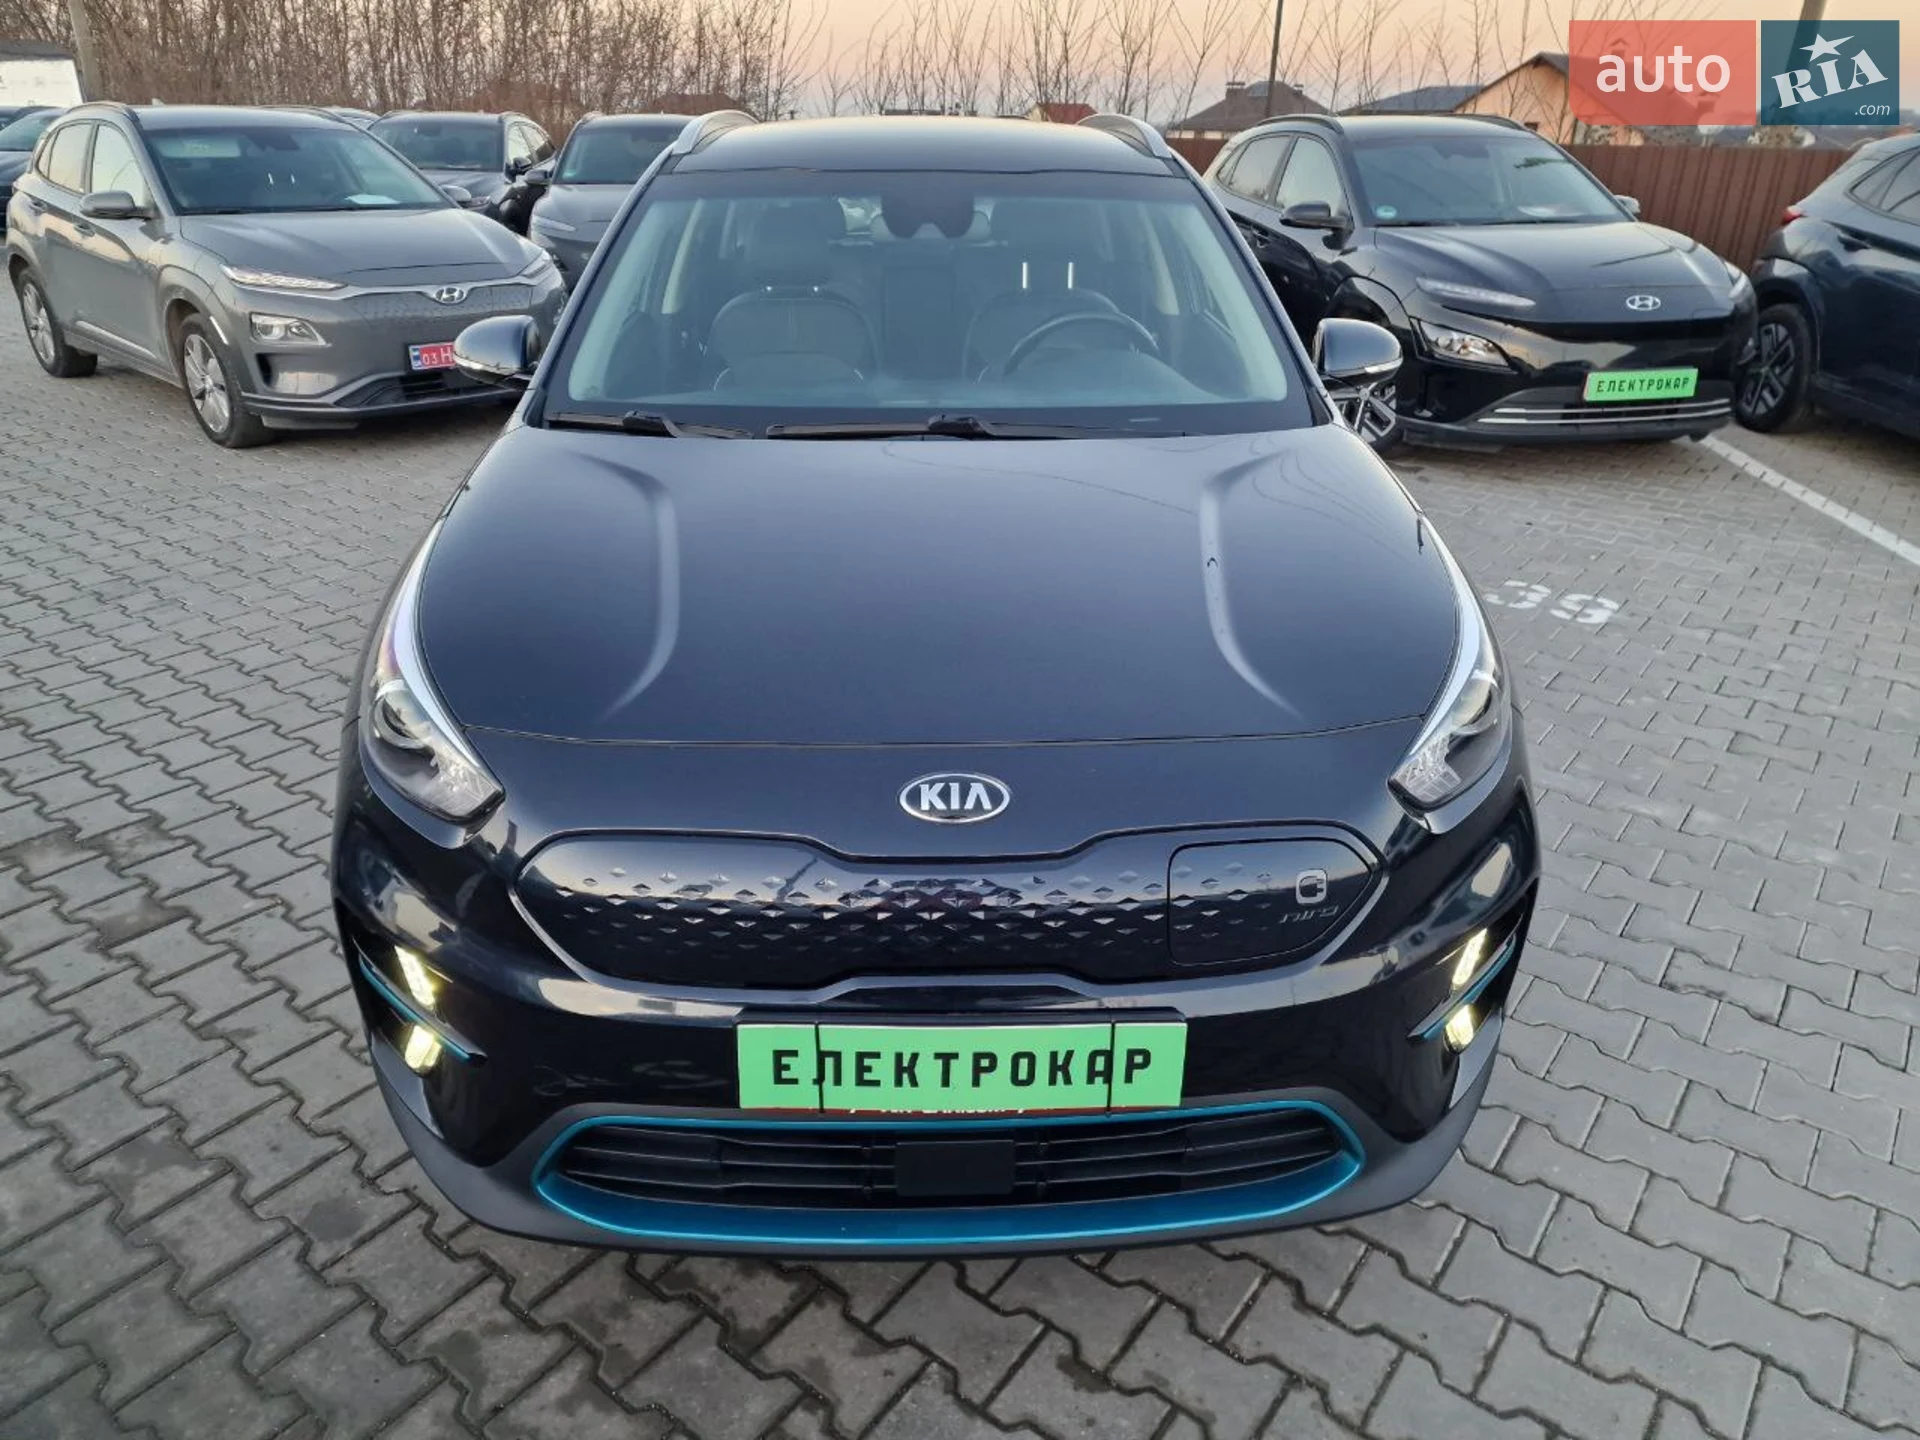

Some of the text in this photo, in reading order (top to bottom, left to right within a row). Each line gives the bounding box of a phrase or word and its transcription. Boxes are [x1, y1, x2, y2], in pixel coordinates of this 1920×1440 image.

[1596, 377, 1690, 393] ЕЛЕКТРОКАР
[919, 782, 992, 811] KIA
[771, 1048, 1152, 1089] ЕЛЕКТРОКАР
